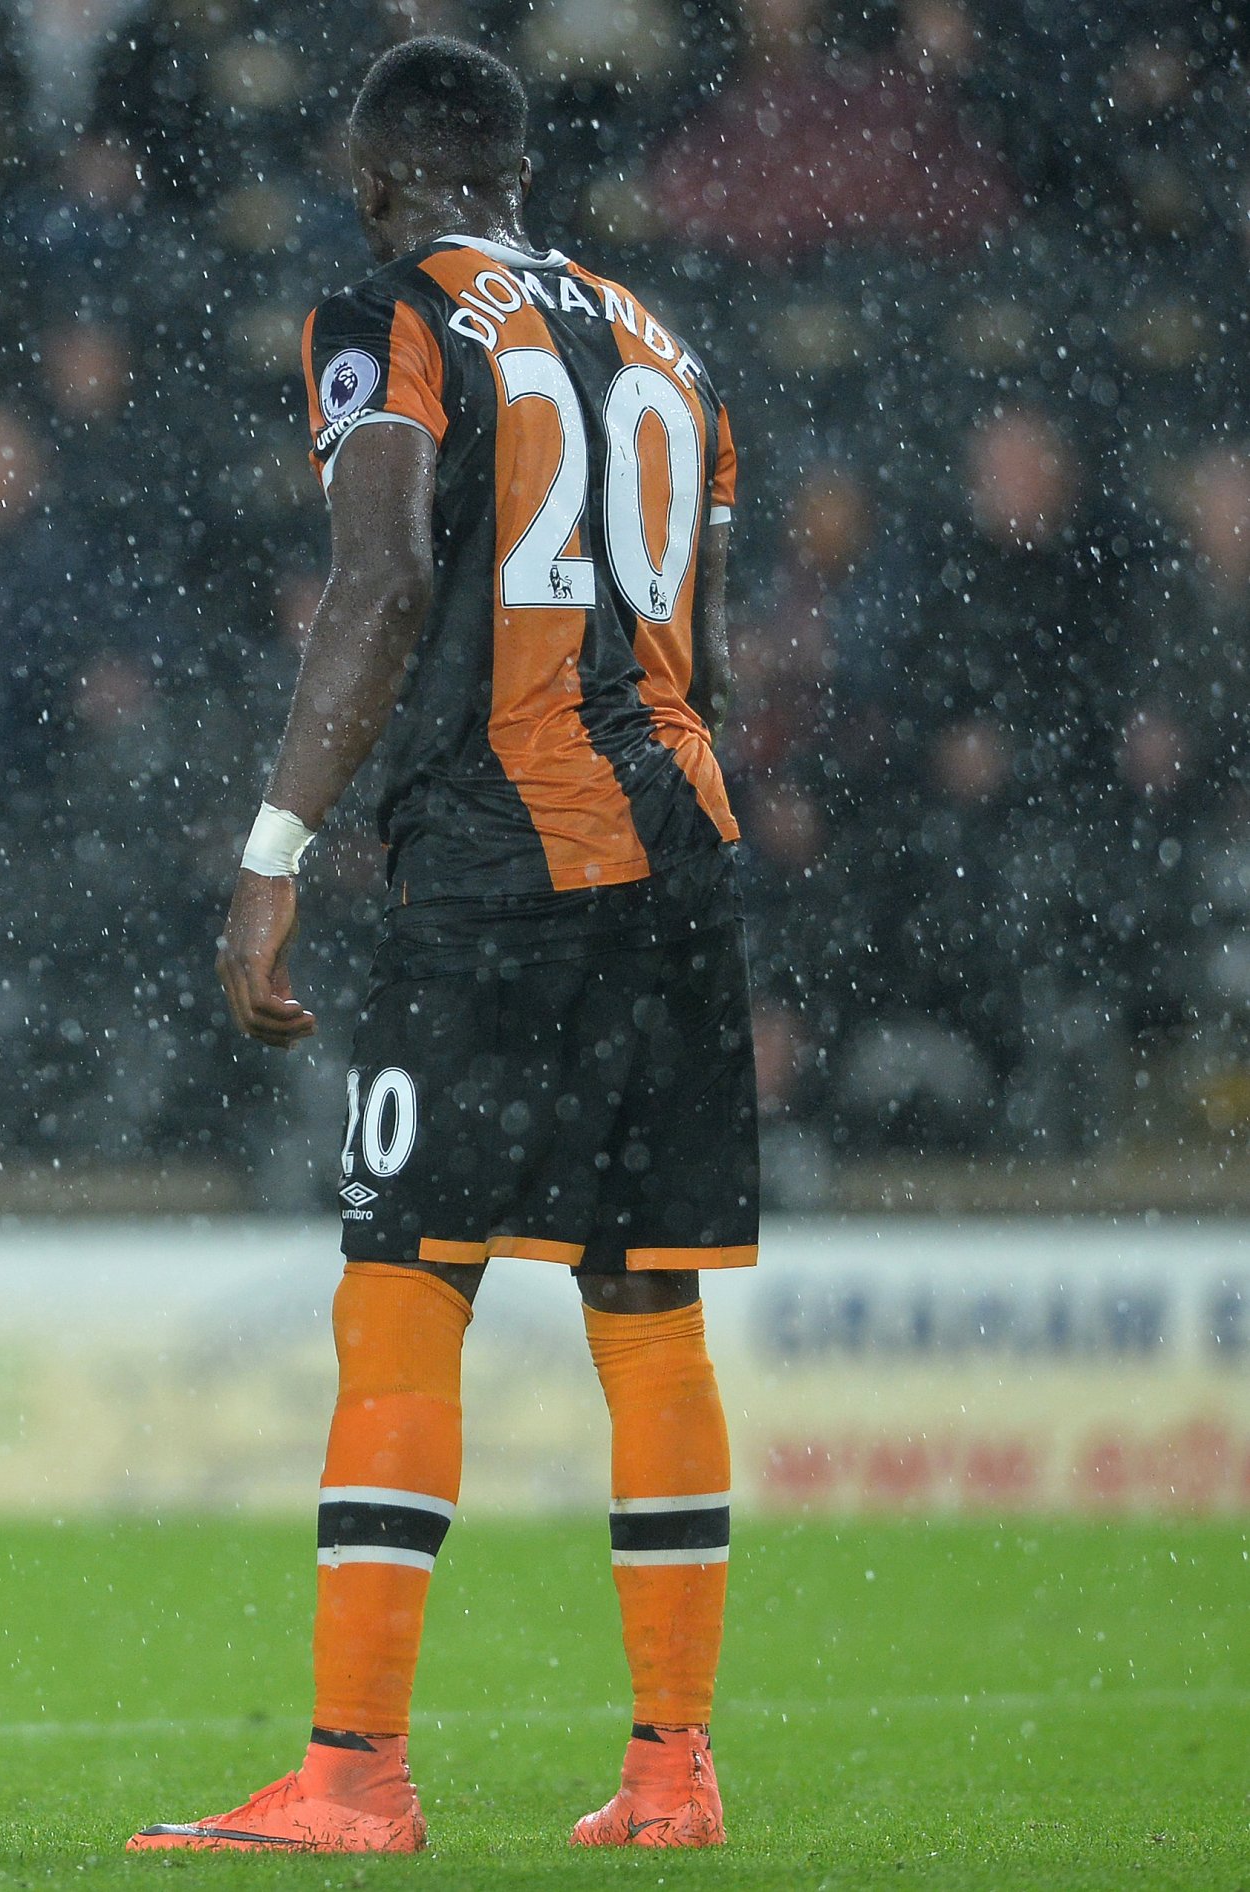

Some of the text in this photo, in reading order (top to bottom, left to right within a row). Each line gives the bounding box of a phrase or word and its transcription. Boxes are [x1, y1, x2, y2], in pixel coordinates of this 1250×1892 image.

[448, 265, 702, 390] DIOMANDE
[495, 346, 700, 624] 20
[341, 1208, 374, 1220] umbro
